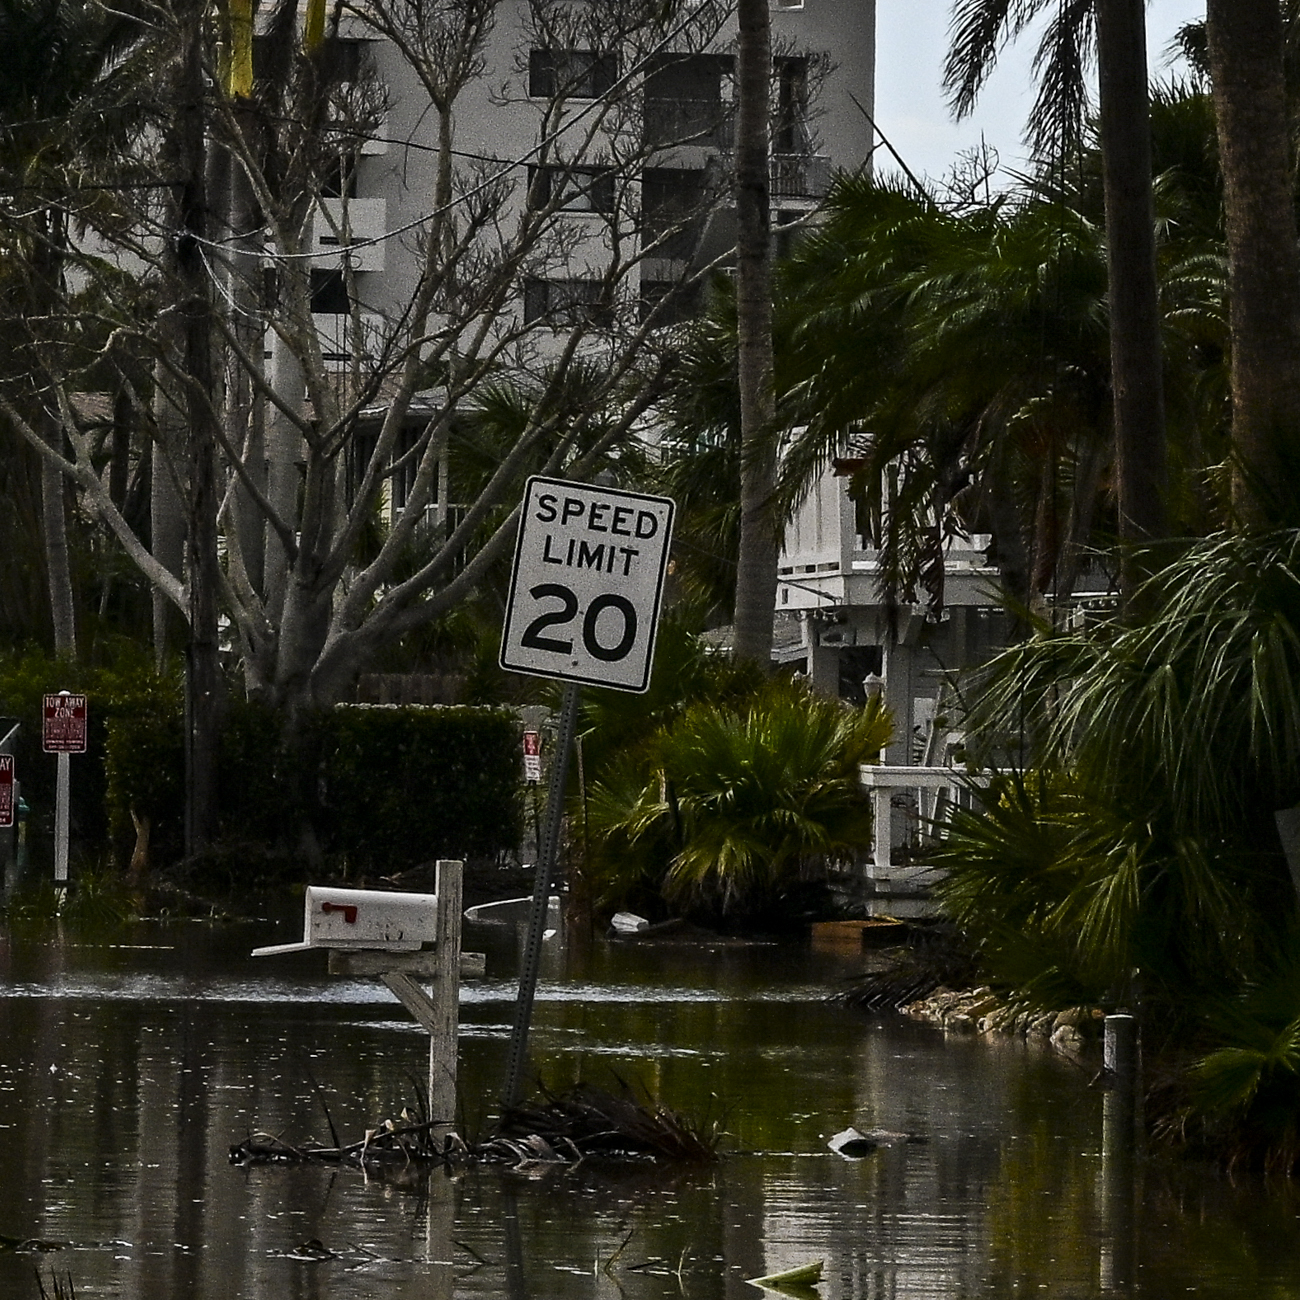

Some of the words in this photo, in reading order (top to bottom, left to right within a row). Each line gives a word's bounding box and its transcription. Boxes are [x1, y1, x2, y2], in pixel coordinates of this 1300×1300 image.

[535, 494, 659, 539] SPEED
[542, 535, 639, 576] LIMIT
[520, 583, 638, 662] 20
[45, 697, 61, 708] TOW
[65, 697, 84, 708] AWAY
[54, 707, 75, 718] ZONE
